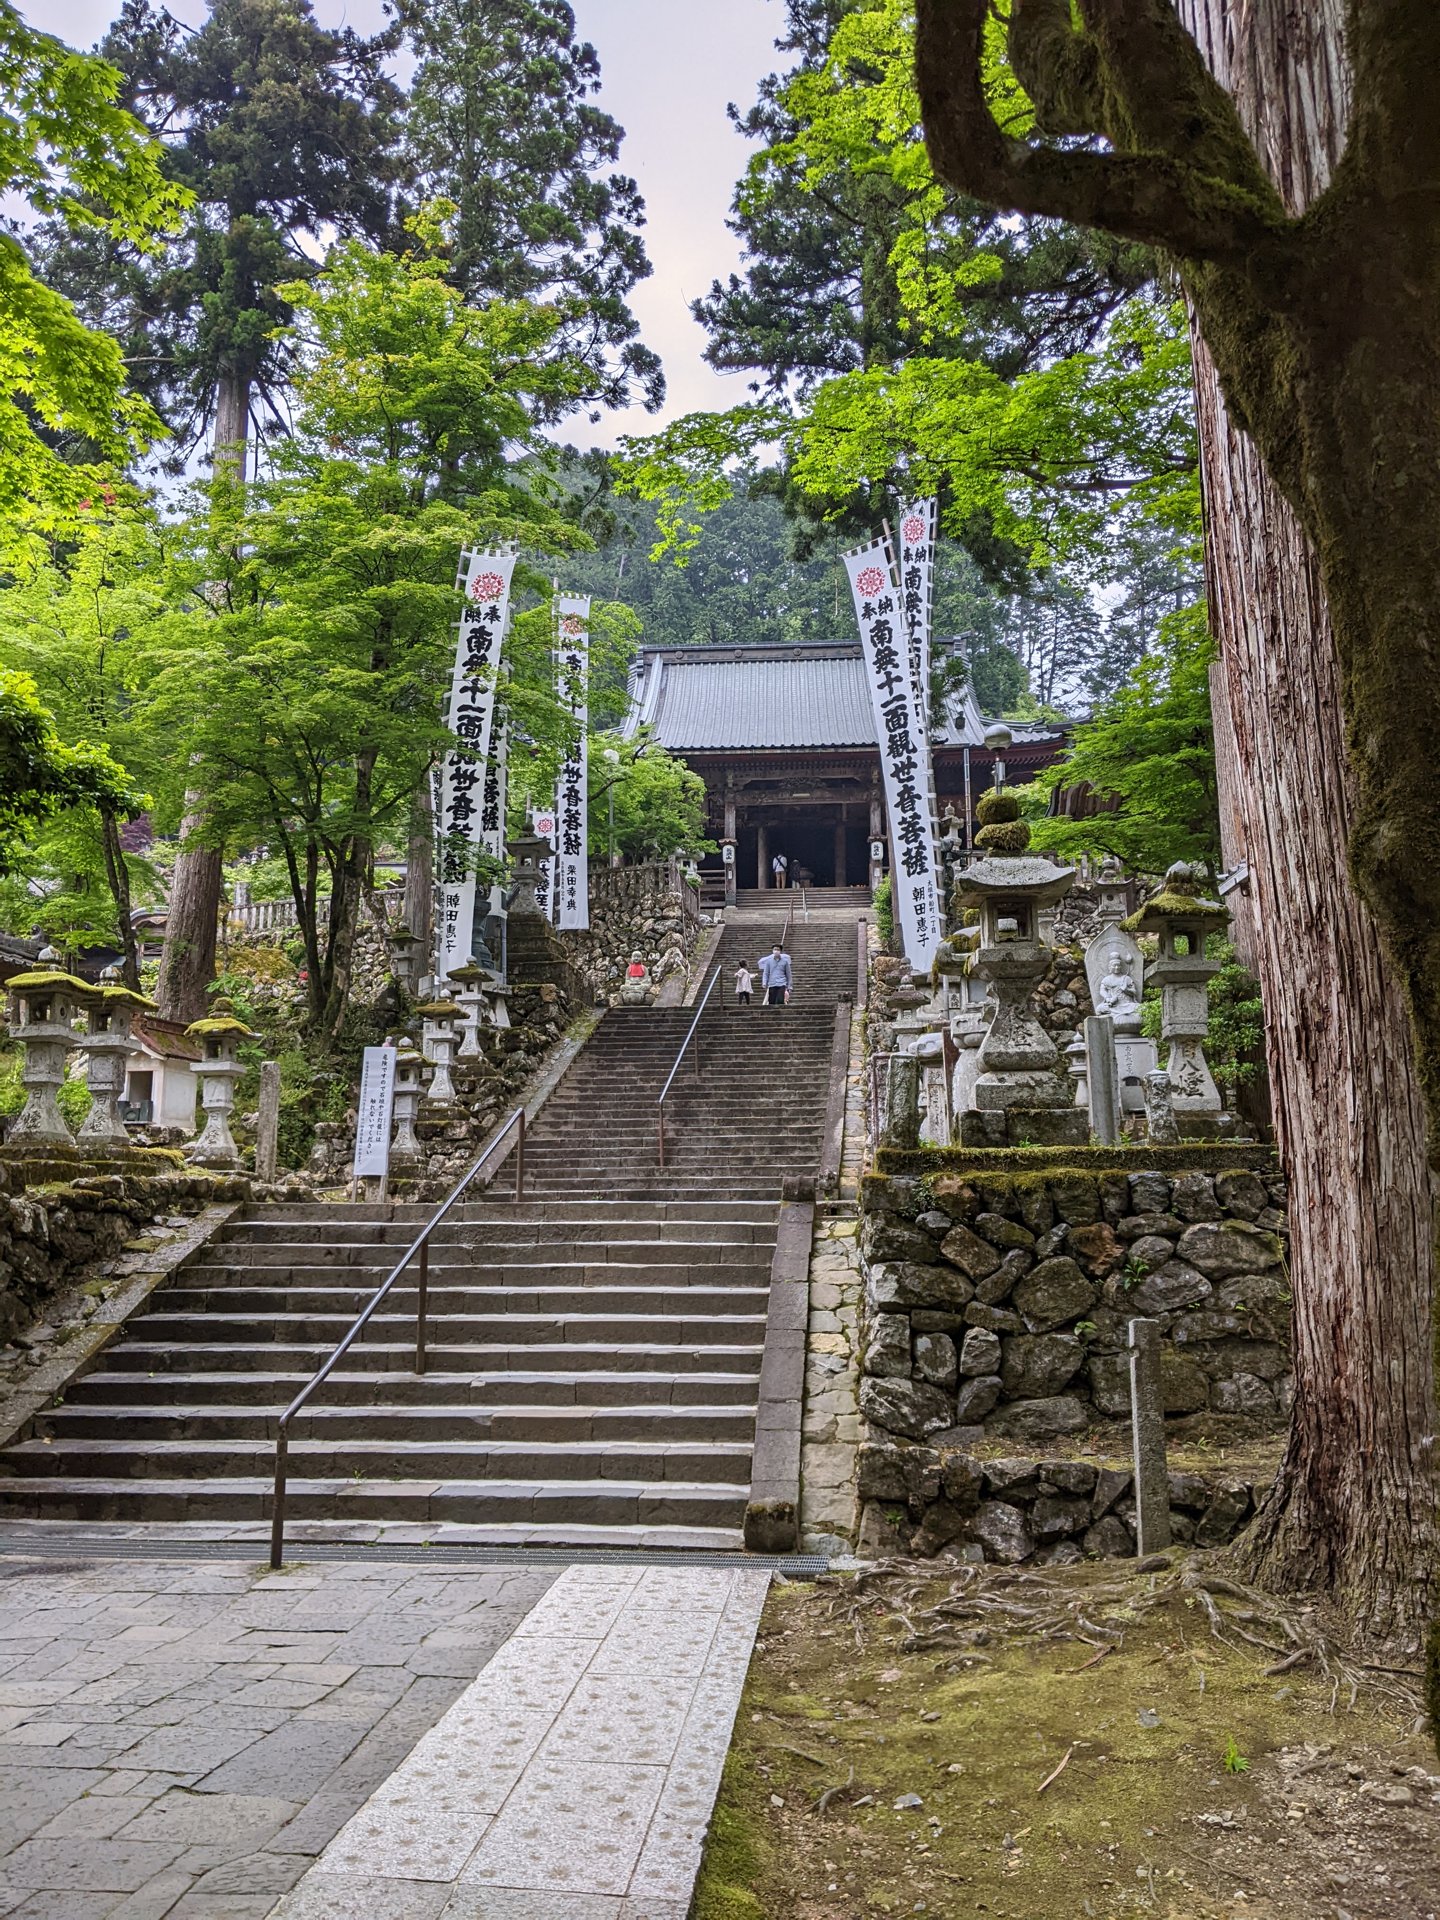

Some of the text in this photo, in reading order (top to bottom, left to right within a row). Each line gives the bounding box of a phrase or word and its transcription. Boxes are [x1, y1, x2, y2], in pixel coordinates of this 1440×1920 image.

[903, 546, 927, 565] 奉納
[861, 596, 894, 621] 奉納
[869, 619, 929, 878] 南無十一面観世音菩薩
